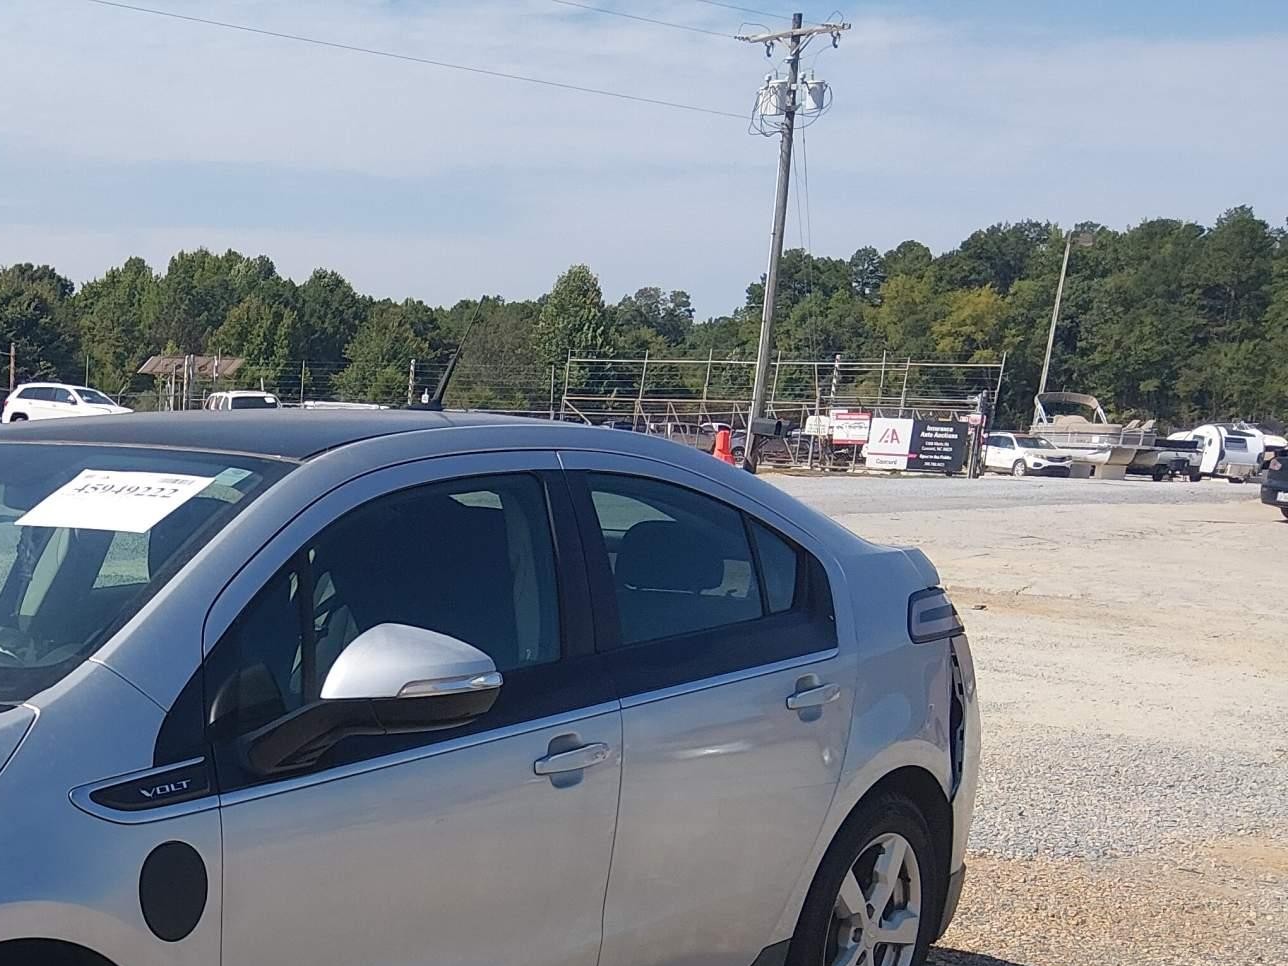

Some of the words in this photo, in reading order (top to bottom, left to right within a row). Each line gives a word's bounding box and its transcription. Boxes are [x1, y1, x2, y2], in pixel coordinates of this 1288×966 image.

[926, 425, 954, 433] Insurance
[73, 483, 180, 498] 45949222
[139, 780, 191, 798] VOLT
